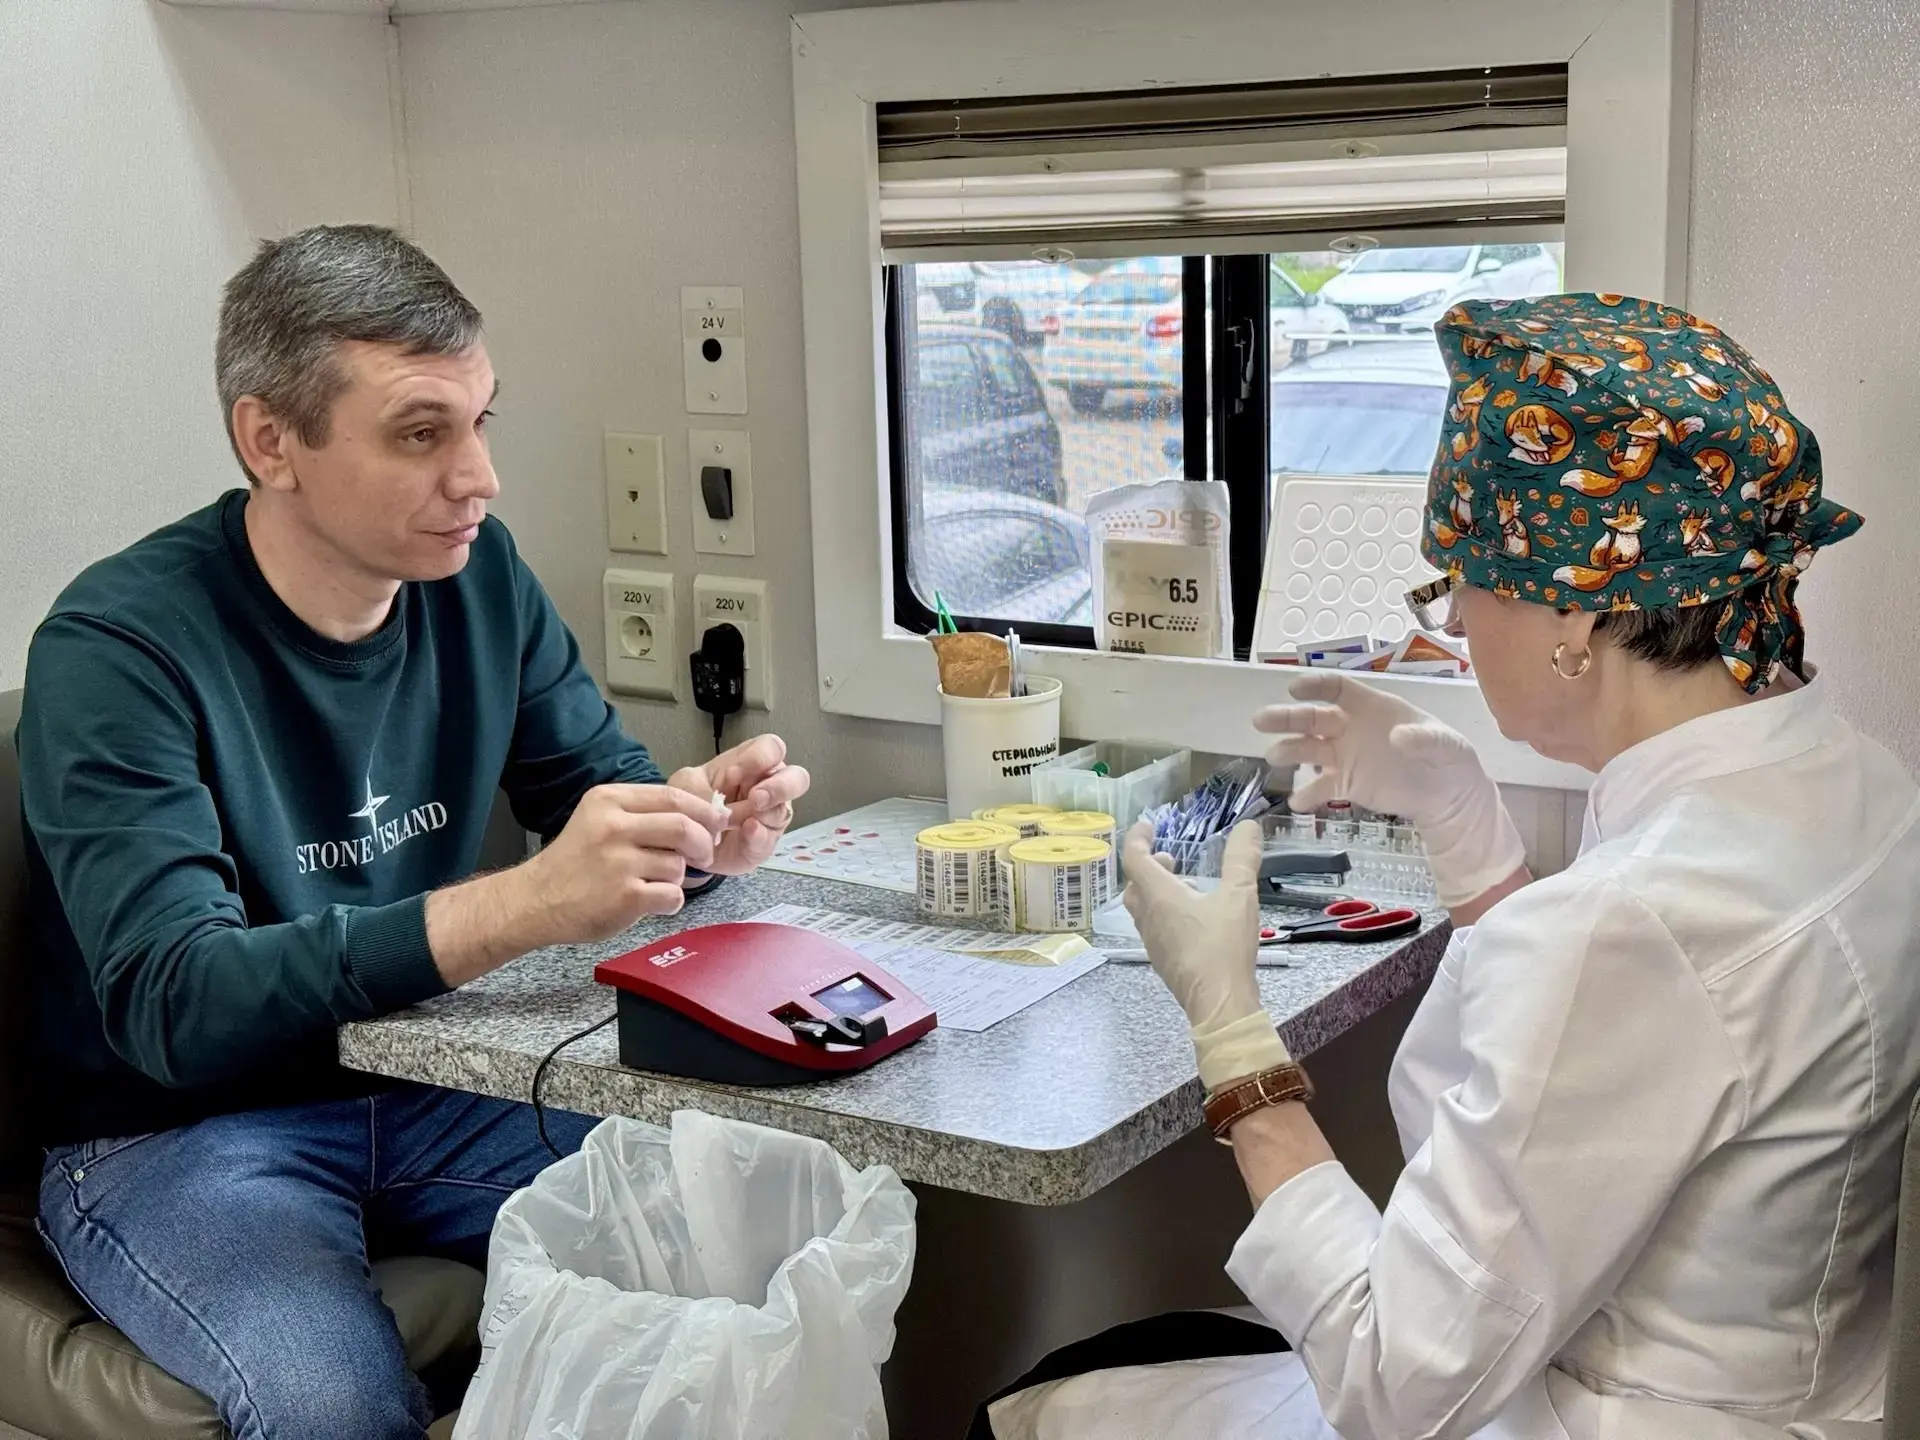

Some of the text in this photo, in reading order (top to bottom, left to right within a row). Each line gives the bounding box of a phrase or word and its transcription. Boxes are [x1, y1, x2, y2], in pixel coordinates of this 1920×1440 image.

[701, 316, 725, 329] 24 V
[623, 591, 652, 604] 220 V
[1168, 577, 1199, 604] 6.5
[715, 597, 745, 612] 220 V
[1107, 611, 1165, 630] EPIC
[295, 801, 448, 874] STONE ISLAND
[648, 945, 687, 967] EKF
